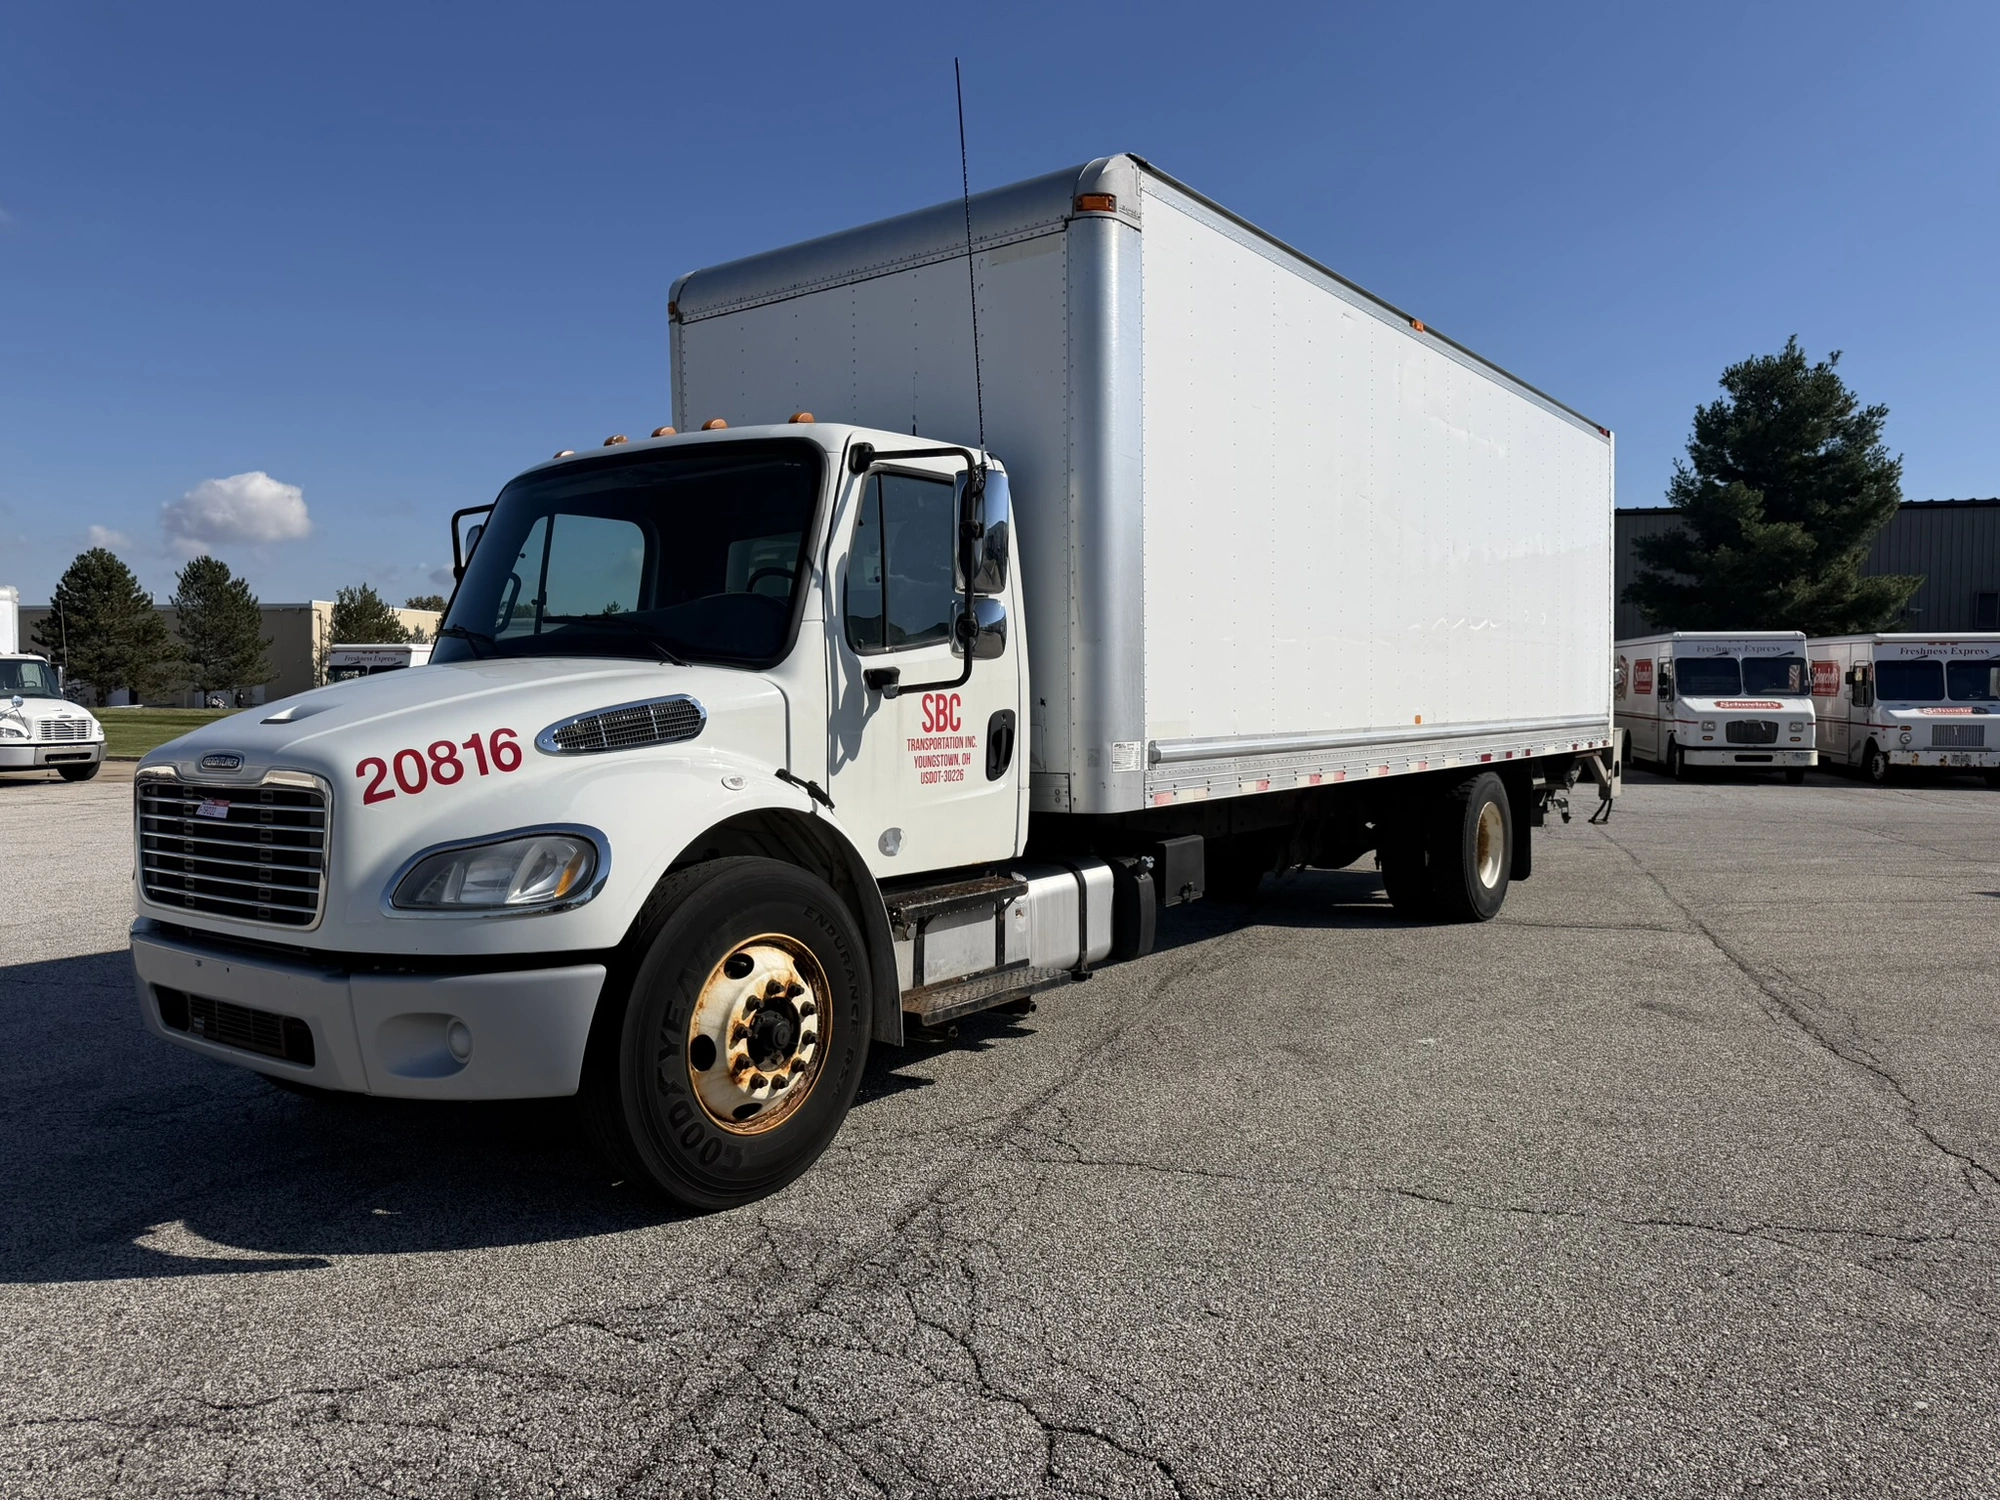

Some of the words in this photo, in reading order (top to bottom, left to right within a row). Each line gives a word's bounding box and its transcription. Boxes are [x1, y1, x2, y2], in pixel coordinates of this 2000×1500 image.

[1697, 645, 1742, 653] Freshness
[1744, 645, 1781, 654] Express
[1900, 647, 1947, 655] Freshness
[1950, 647, 1989, 657] Express
[921, 693, 962, 733] SBC
[906, 736, 964, 752] TRANSPORTATION
[965, 735, 978, 749] INC.
[355, 727, 523, 806] 20816
[914, 753, 961, 769] YOUNGSTOWN,
[962, 752, 971, 765] OH
[920, 768, 964, 785] USDOT-30226
[804, 905, 860, 1037] ENDURANCE
